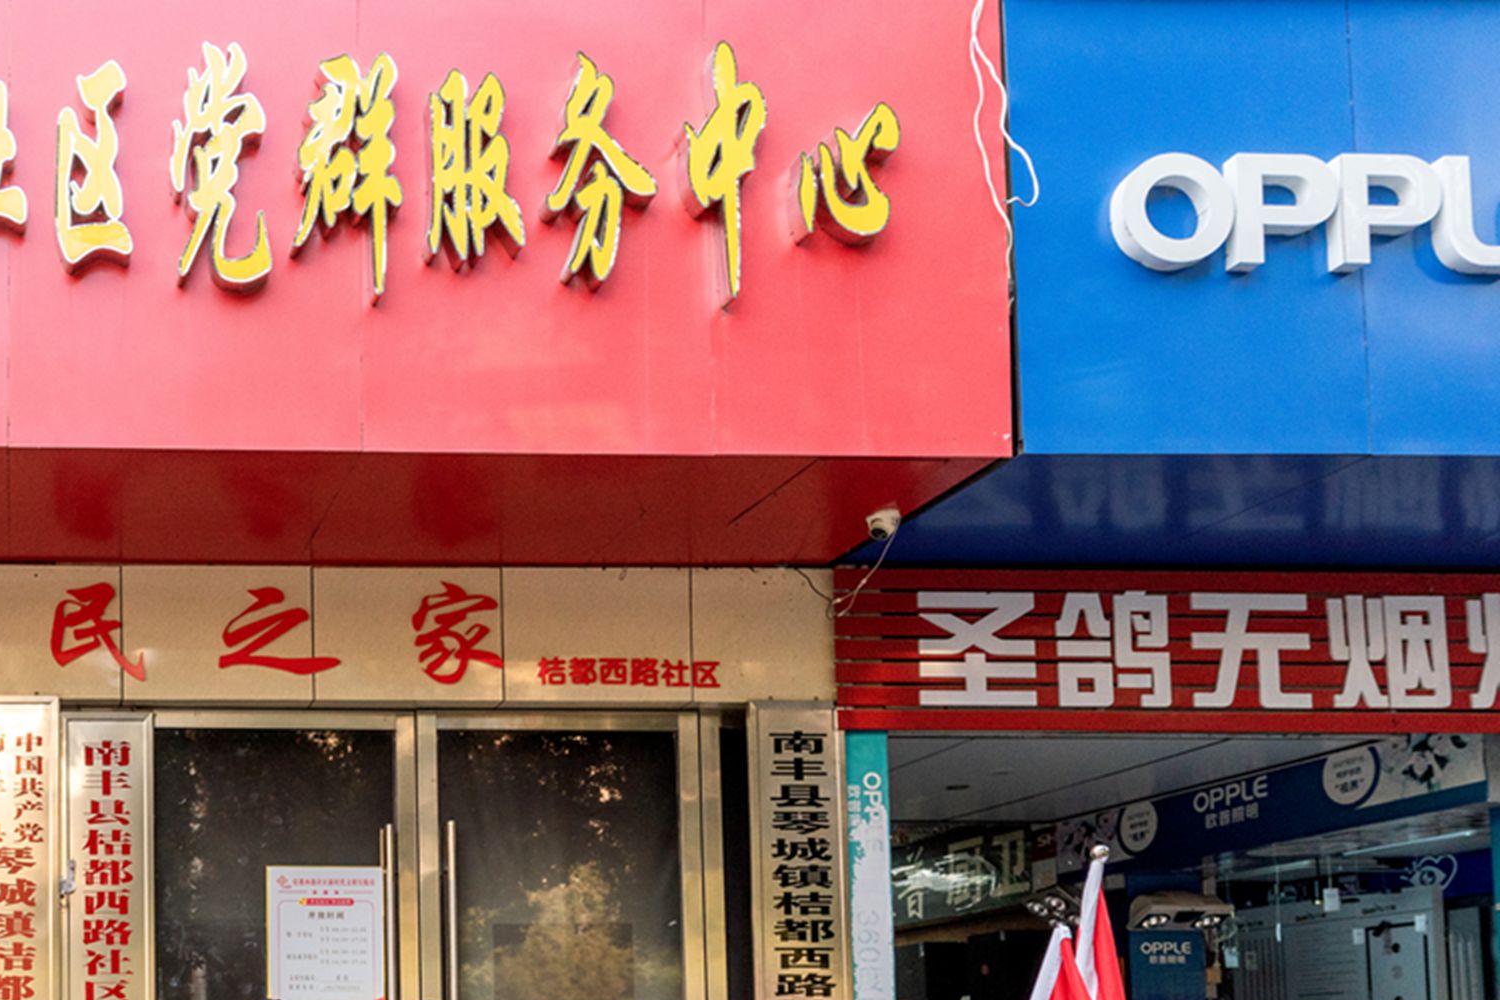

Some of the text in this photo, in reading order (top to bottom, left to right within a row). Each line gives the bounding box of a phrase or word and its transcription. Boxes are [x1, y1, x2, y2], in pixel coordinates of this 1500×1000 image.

[537, 656, 721, 688] 桔都西路社区
[14, 732, 44, 844] 中国共产党
[1193, 775, 1269, 813] OPPLE
[1140, 941, 1192, 955] OPPLE
